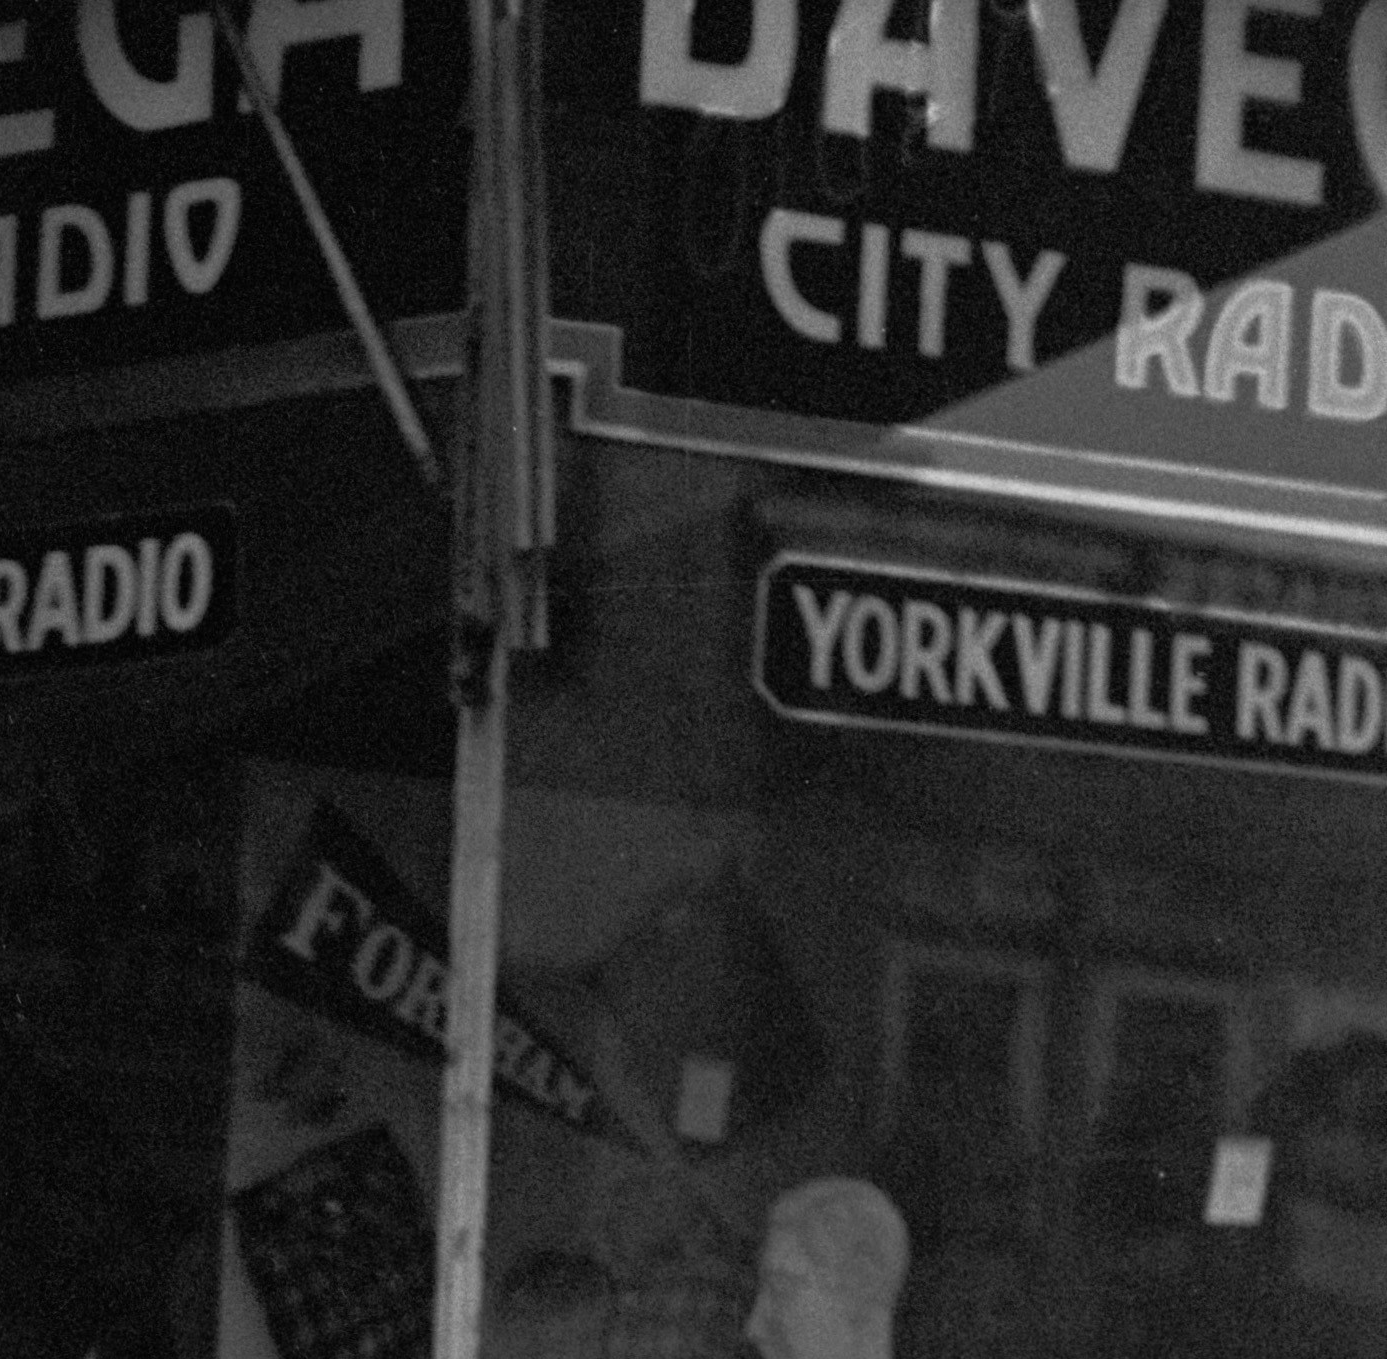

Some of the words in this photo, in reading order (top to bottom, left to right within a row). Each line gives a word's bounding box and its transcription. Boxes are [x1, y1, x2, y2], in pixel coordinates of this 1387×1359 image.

[640, 0, 1387, 204] DAVE
[760, 206, 1067, 372] CITY
[1114, 262, 1387, 421] RAD
[793, 583, 1211, 735] YORKVILLE
[1235, 640, 1383, 755] RAD
